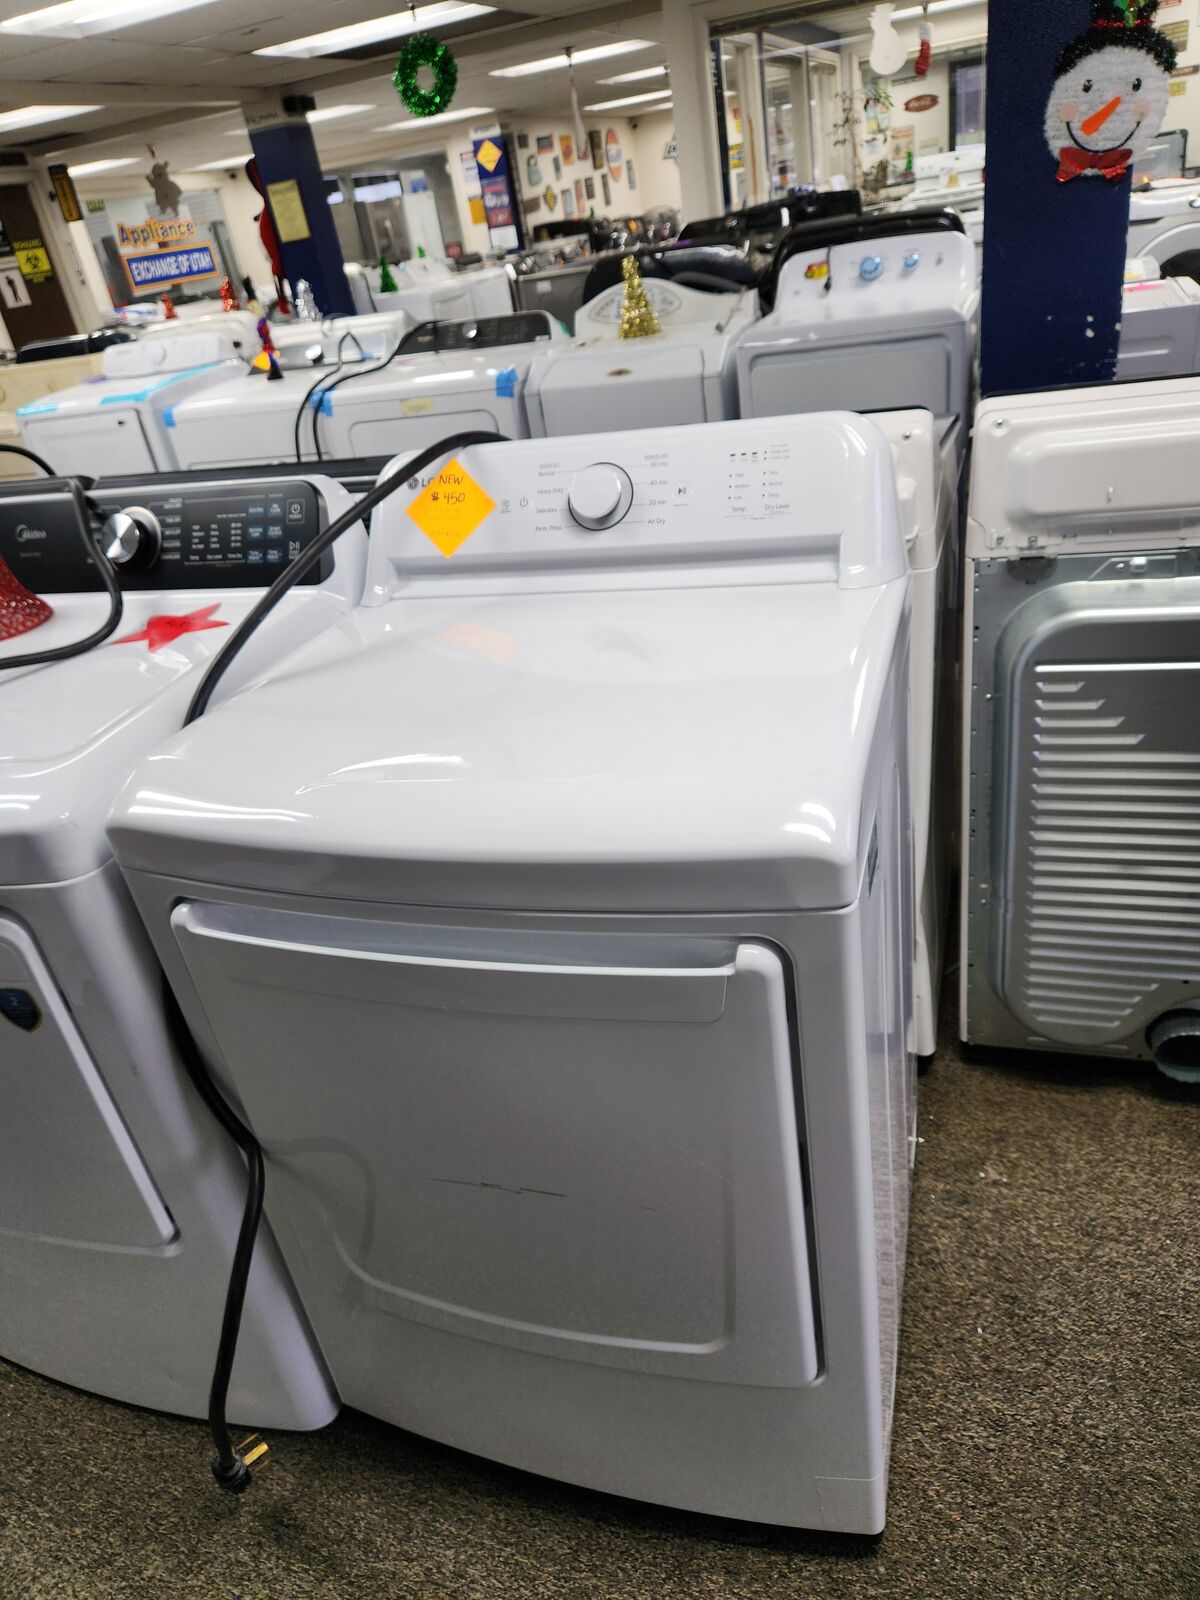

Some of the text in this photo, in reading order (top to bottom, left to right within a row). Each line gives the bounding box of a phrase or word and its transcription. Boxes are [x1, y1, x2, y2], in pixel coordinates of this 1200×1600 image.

[119, 219, 194, 246] Appliance
[131, 251, 213, 282] EXCHANGE OF UTAH
[439, 474, 464, 486] NEW
